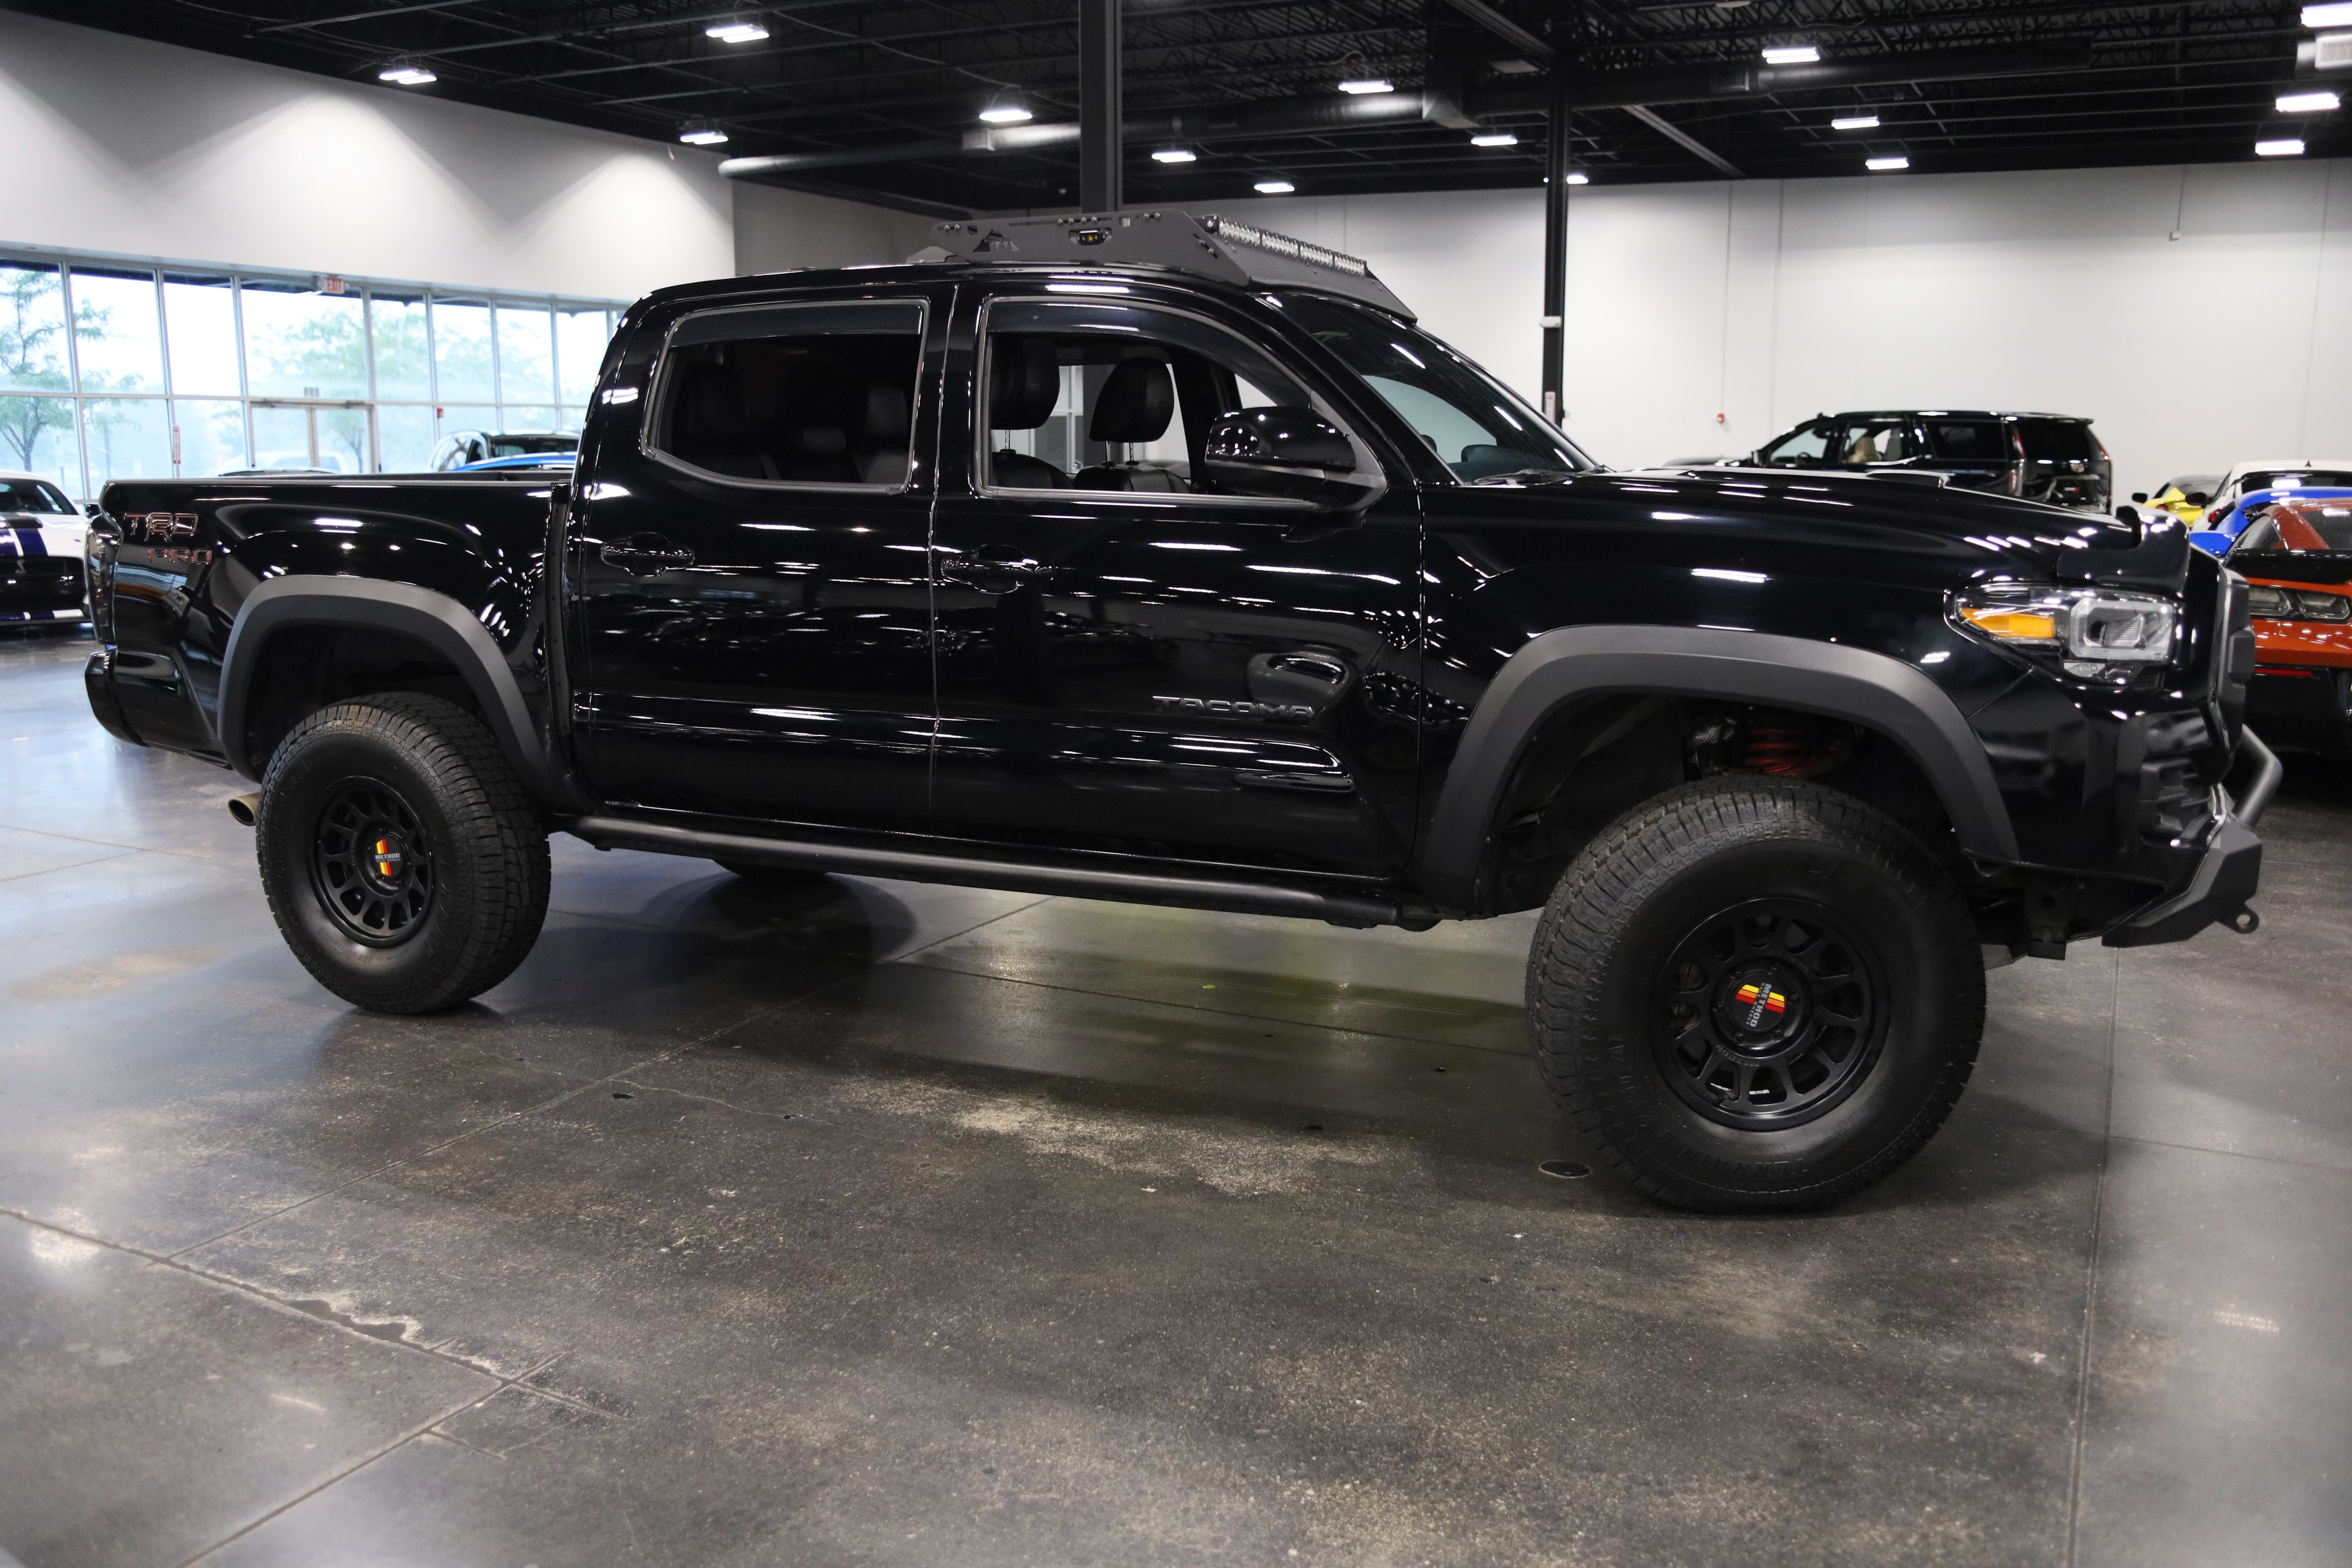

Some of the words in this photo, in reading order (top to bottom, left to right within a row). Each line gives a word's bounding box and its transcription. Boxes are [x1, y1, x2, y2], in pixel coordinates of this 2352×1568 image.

[327, 278, 342, 292] EXIT
[123, 512, 199, 542] TRD
[147, 546, 212, 565] PRO
[2074, 664, 2098, 675] TRD
[1152, 696, 1316, 719] TACOMA
[1756, 982, 1765, 998] RACE
[1746, 1001, 1758, 1025] WHEELS
[1750, 983, 1772, 1027] METHOD
[1716, 1044, 1760, 1067] METHOD
